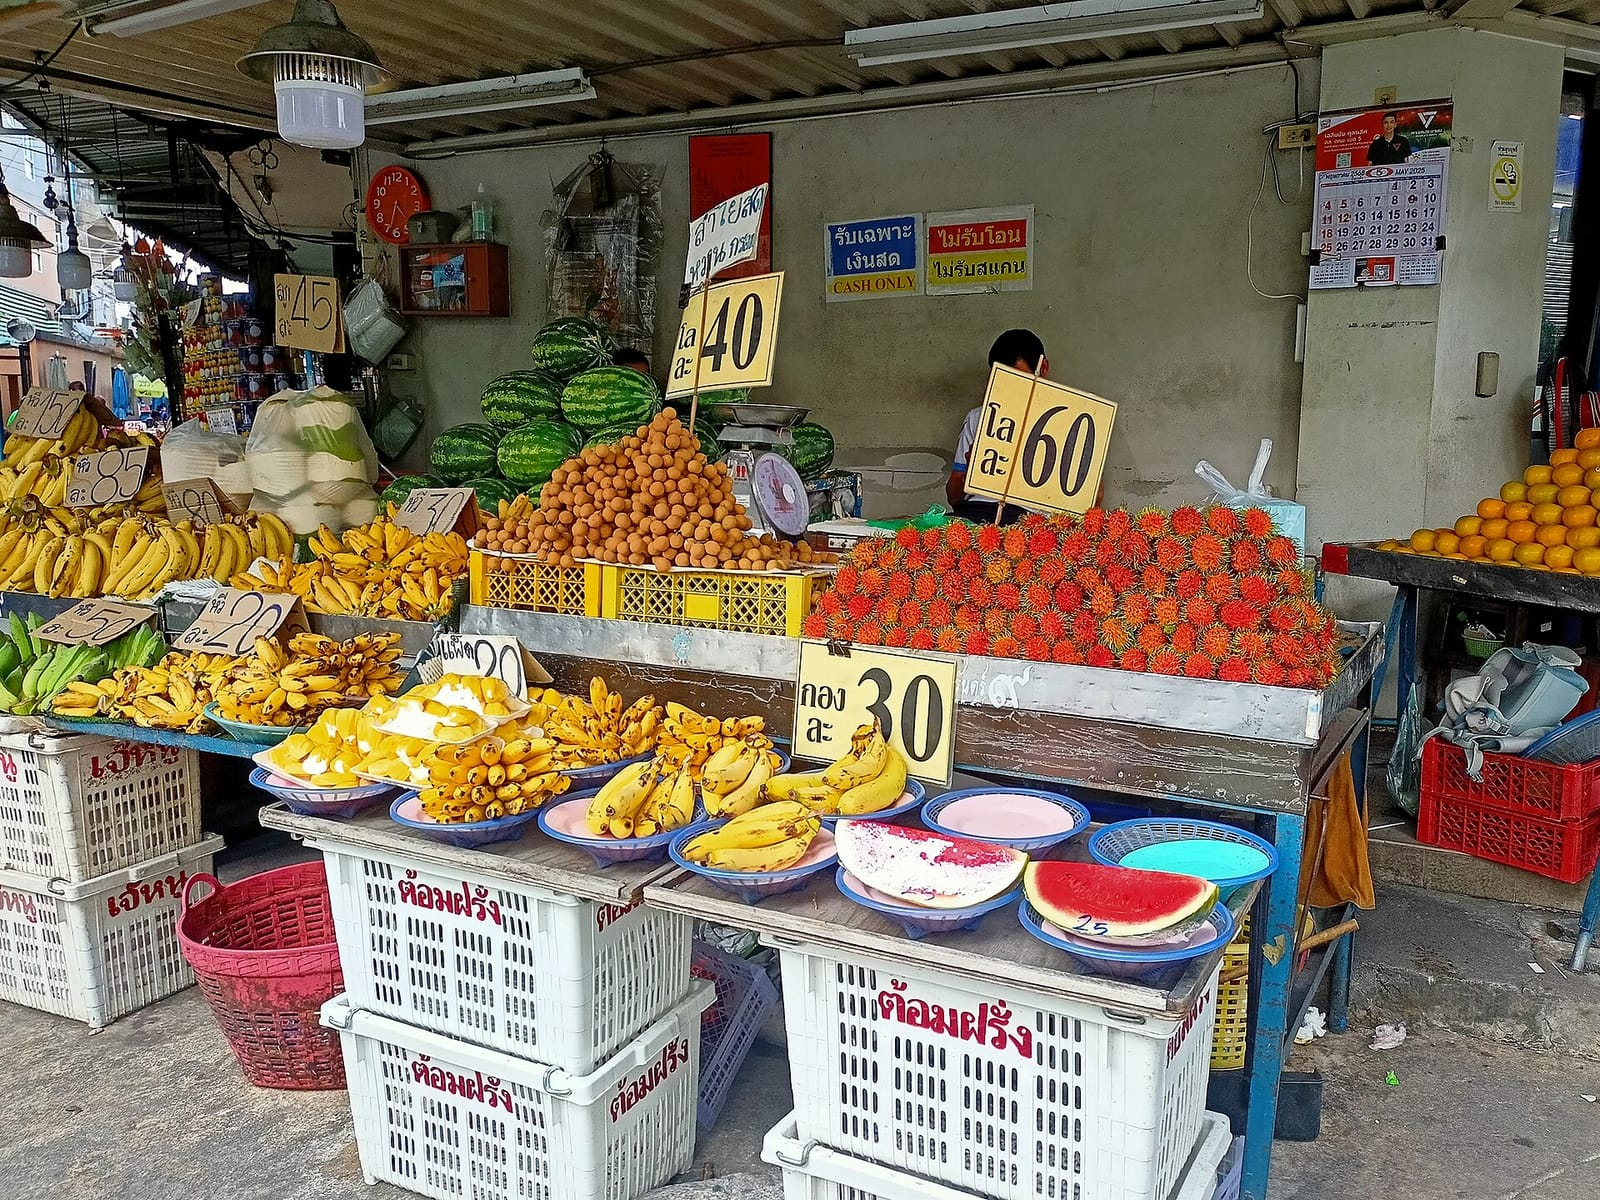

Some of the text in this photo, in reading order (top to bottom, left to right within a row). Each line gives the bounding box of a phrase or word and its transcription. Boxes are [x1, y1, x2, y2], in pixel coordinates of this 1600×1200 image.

[384, 176, 391, 185] 11
[391, 172, 402, 183] 12
[405, 176, 410, 186] 1
[1394, 168, 1409, 176] MAY
[1409, 166, 1426, 175] 2025
[376, 187, 386, 197] 10
[410, 185, 418, 196] 2
[1410, 180, 1416, 189] 2
[1428, 179, 1434, 188] 3
[373, 199, 381, 209] 9
[414, 201, 420, 211] 3
[1324, 201, 1331, 210] 4
[1340, 200, 1347, 209] 5
[1358, 198, 1363, 207] 6
[1375, 197, 1381, 206] 7
[1392, 195, 1398, 204] 8
[1425, 193, 1436, 203] 10
[376, 213, 384, 224] 8
[694, 187, 764, 247] ลำไยสด
[1322, 208, 1435, 224] 11 12 13 14 15 16 17
[384, 224, 391, 233] 7
[392, 228, 400, 238] 6
[834, 224, 912, 246] รับเฉพาะ
[938, 225, 1020, 248] ไม่รับโอน
[1322, 222, 1434, 239] 18 19 20 21 22 23 24
[1321, 237, 1433, 252] 25 26 27 28 29 30 31
[846, 251, 901, 271] เงินสด
[932, 259, 1025, 279] ไม่รับสแกน
[832, 274, 915, 294] CASH ONLY
[291, 275, 332, 331] 45
[678, 293, 763, 373] โล 40
[674, 356, 694, 380] ละ
[31, 391, 80, 435] 150
[986, 401, 1096, 497] โล 60
[980, 448, 1009, 476] ละ
[91, 448, 149, 504] 85
[69, 488, 86, 502] ละ
[65, 608, 135, 641] 50
[203, 592, 282, 655] 20
[184, 627, 208, 644] ละ
[800, 683, 846, 712] กอง
[857, 667, 943, 763] 30
[806, 717, 834, 744] ละ
[397, 868, 502, 926] ต้อมฝรั่ง
[1072, 914, 1108, 935] 25
[878, 978, 1032, 1059] ต้อมฝรั่ง
[411, 1054, 514, 1114] ต้อมฝรั่ง
[610, 1036, 689, 1123] ต้อมฝรั่ง
